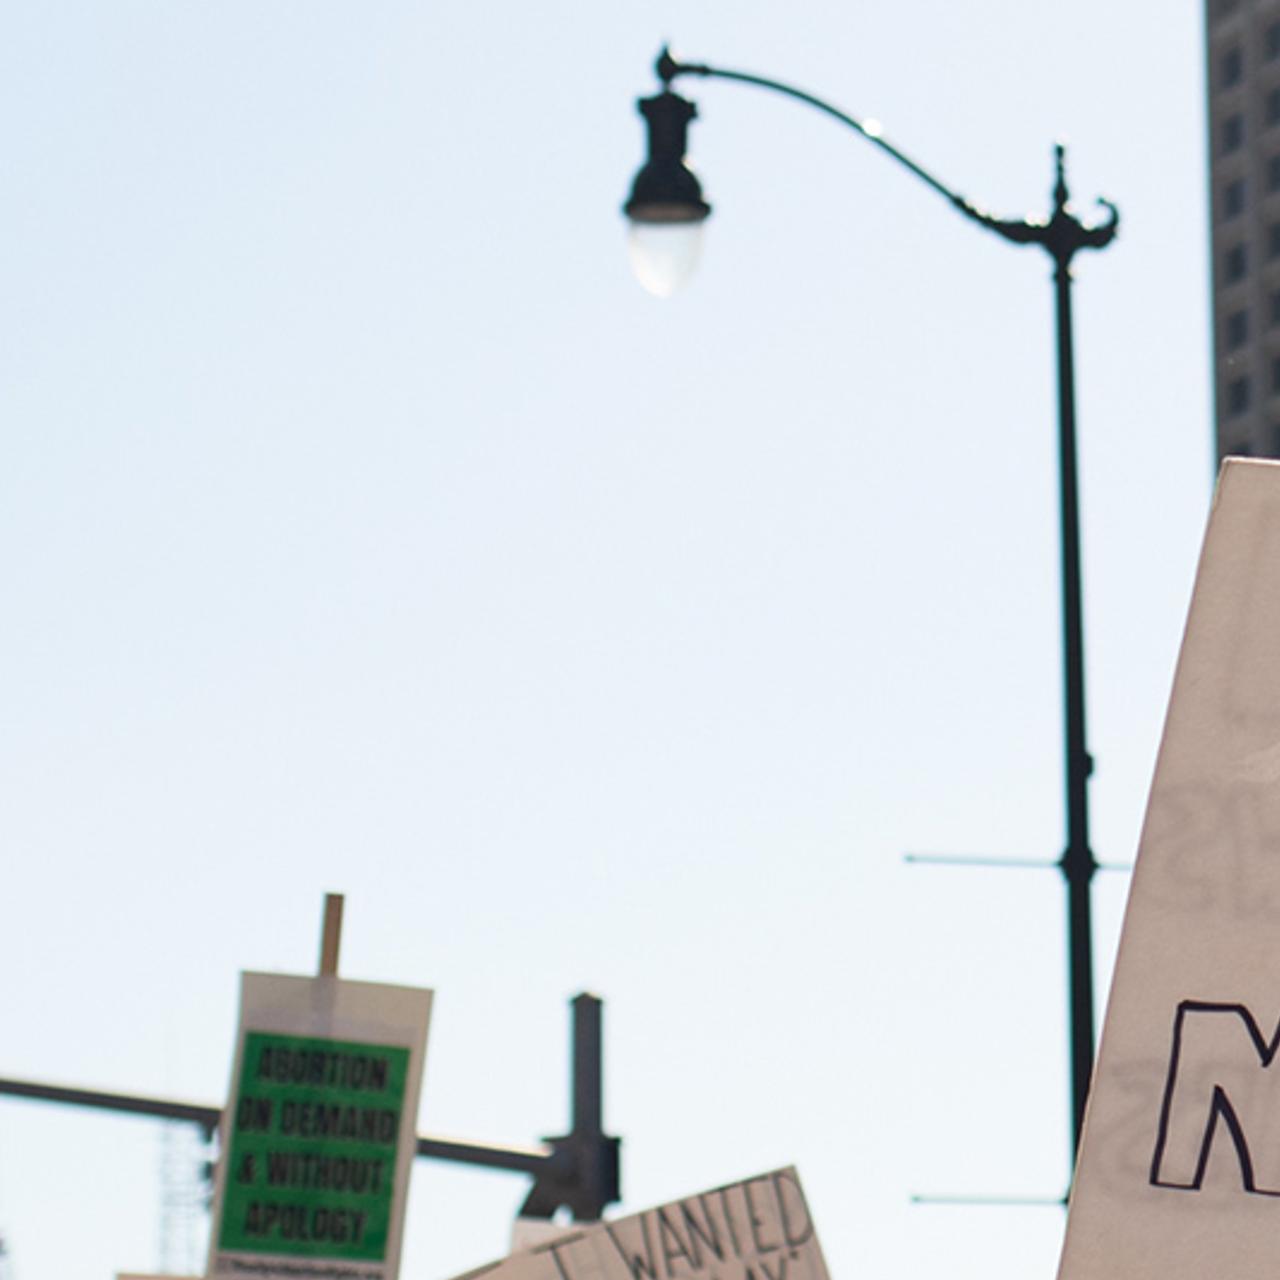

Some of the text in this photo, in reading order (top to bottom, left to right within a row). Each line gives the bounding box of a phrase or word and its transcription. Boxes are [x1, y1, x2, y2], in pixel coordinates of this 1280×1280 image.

[258, 1045, 389, 1092] ABORTION
[236, 1096, 400, 1146] ON DEMAND
[266, 1151, 384, 1194] WITHOUT
[244, 1200, 369, 1245] APOLOGY
